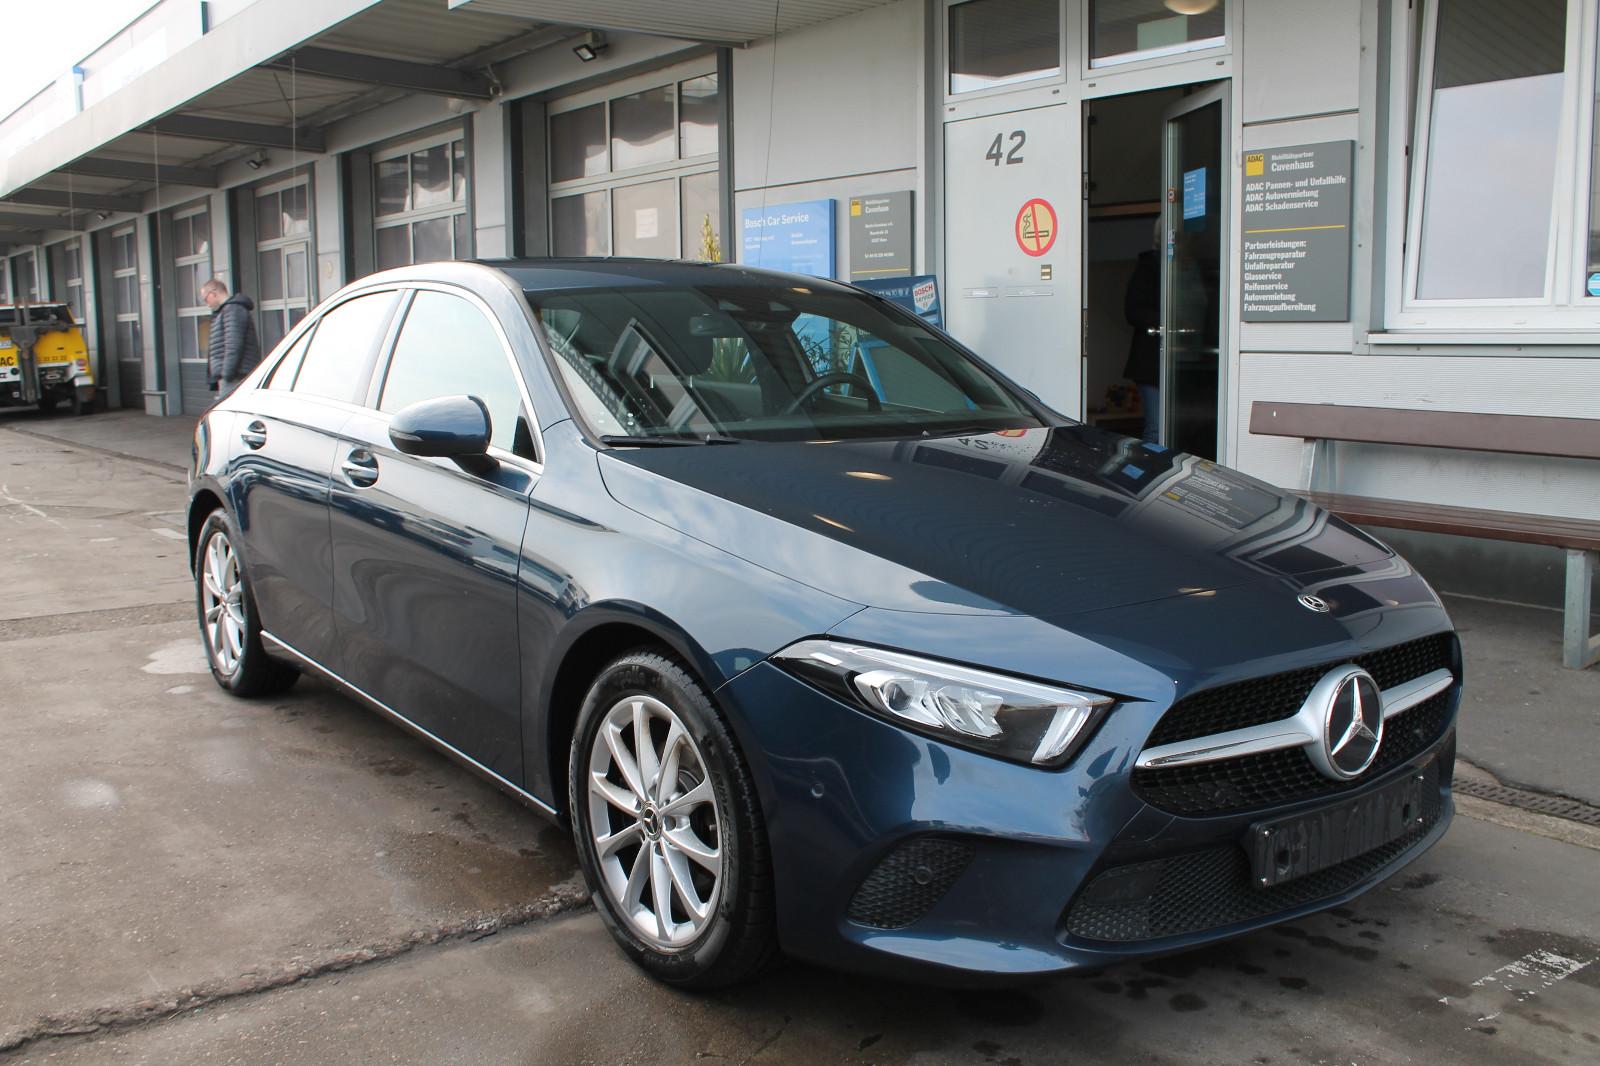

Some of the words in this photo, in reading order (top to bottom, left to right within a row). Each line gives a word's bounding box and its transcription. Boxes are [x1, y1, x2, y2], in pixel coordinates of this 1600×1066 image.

[985, 130, 1027, 167] 42
[1247, 154, 1264, 162] ADAC
[1271, 160, 1314, 172] Cuvenhaus
[1245, 182, 1264, 191] ADAC
[1265, 181, 1293, 190] Pannen-
[1295, 177, 1308, 187] und
[1310, 175, 1347, 186] Unfallhilfe
[1245, 193, 1264, 202] ADAC
[1265, 190, 1319, 201] Autovermietung
[1245, 203, 1264, 212] ADAC
[1265, 200, 1319, 211] Schadenservice
[767, 216, 781, 226] Car
[781, 212, 809, 225] Service
[1244, 240, 1307, 250] Partnerleistungen:
[1244, 251, 1306, 260] Fahrzeugreparatur
[1244, 261, 1295, 271] Unfallreparatur
[1244, 271, 1282, 280] Glasservice
[914, 282, 933, 297] BOSCH
[1244, 282, 1289, 291] Reifenservice
[1244, 293, 1296, 301] Autovermietung
[1243, 302, 1316, 313] Fahrzeugaufbereitung
